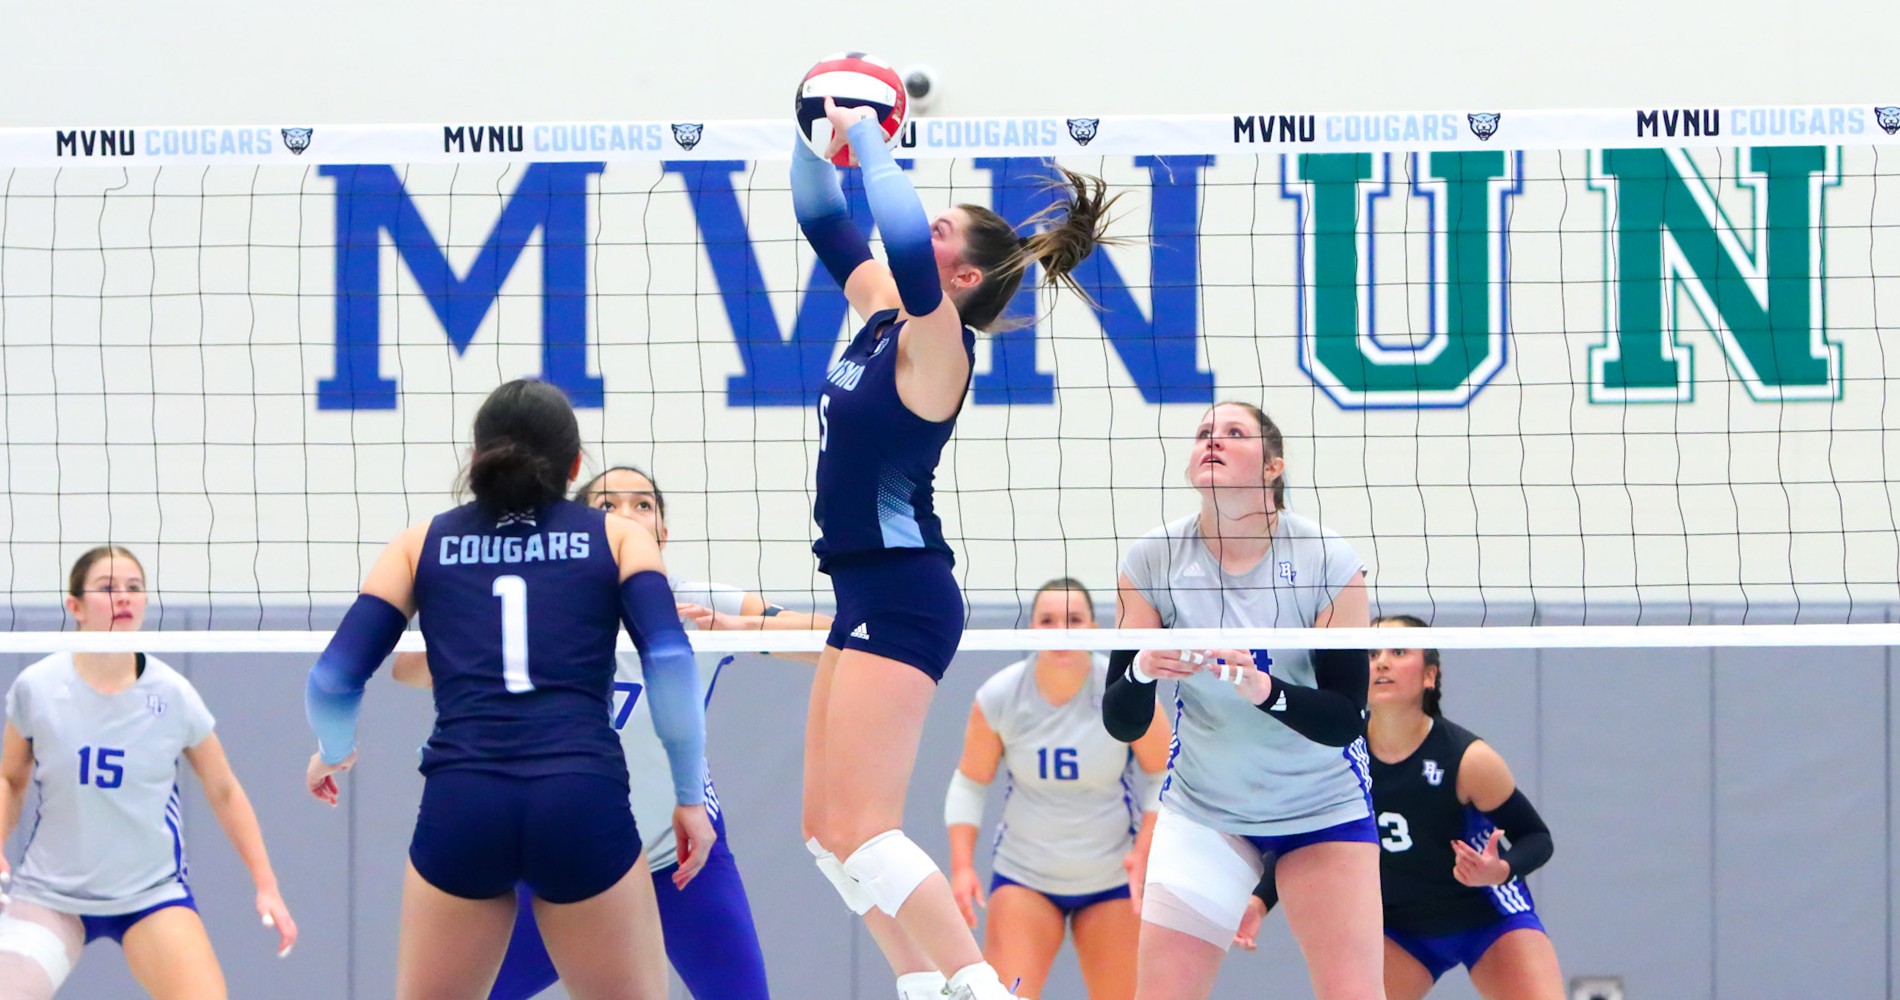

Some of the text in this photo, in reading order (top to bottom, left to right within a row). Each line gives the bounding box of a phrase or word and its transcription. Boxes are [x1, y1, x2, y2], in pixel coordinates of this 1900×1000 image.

[444, 124, 663, 153] MVNU COUGARS
[926, 119, 1058, 148] COUGARS
[1233, 113, 1459, 144] MVNU COUGARS
[1637, 107, 1865, 138] MVNU COUGARS
[56, 128, 273, 157] MVNU COUGARS
[439, 531, 590, 566] COUGARS
[492, 574, 537, 694] 1
[613, 681, 644, 730] 7
[77, 745, 126, 789] 15
[1037, 747, 1080, 780] 16
[1377, 811, 1414, 853] 3
